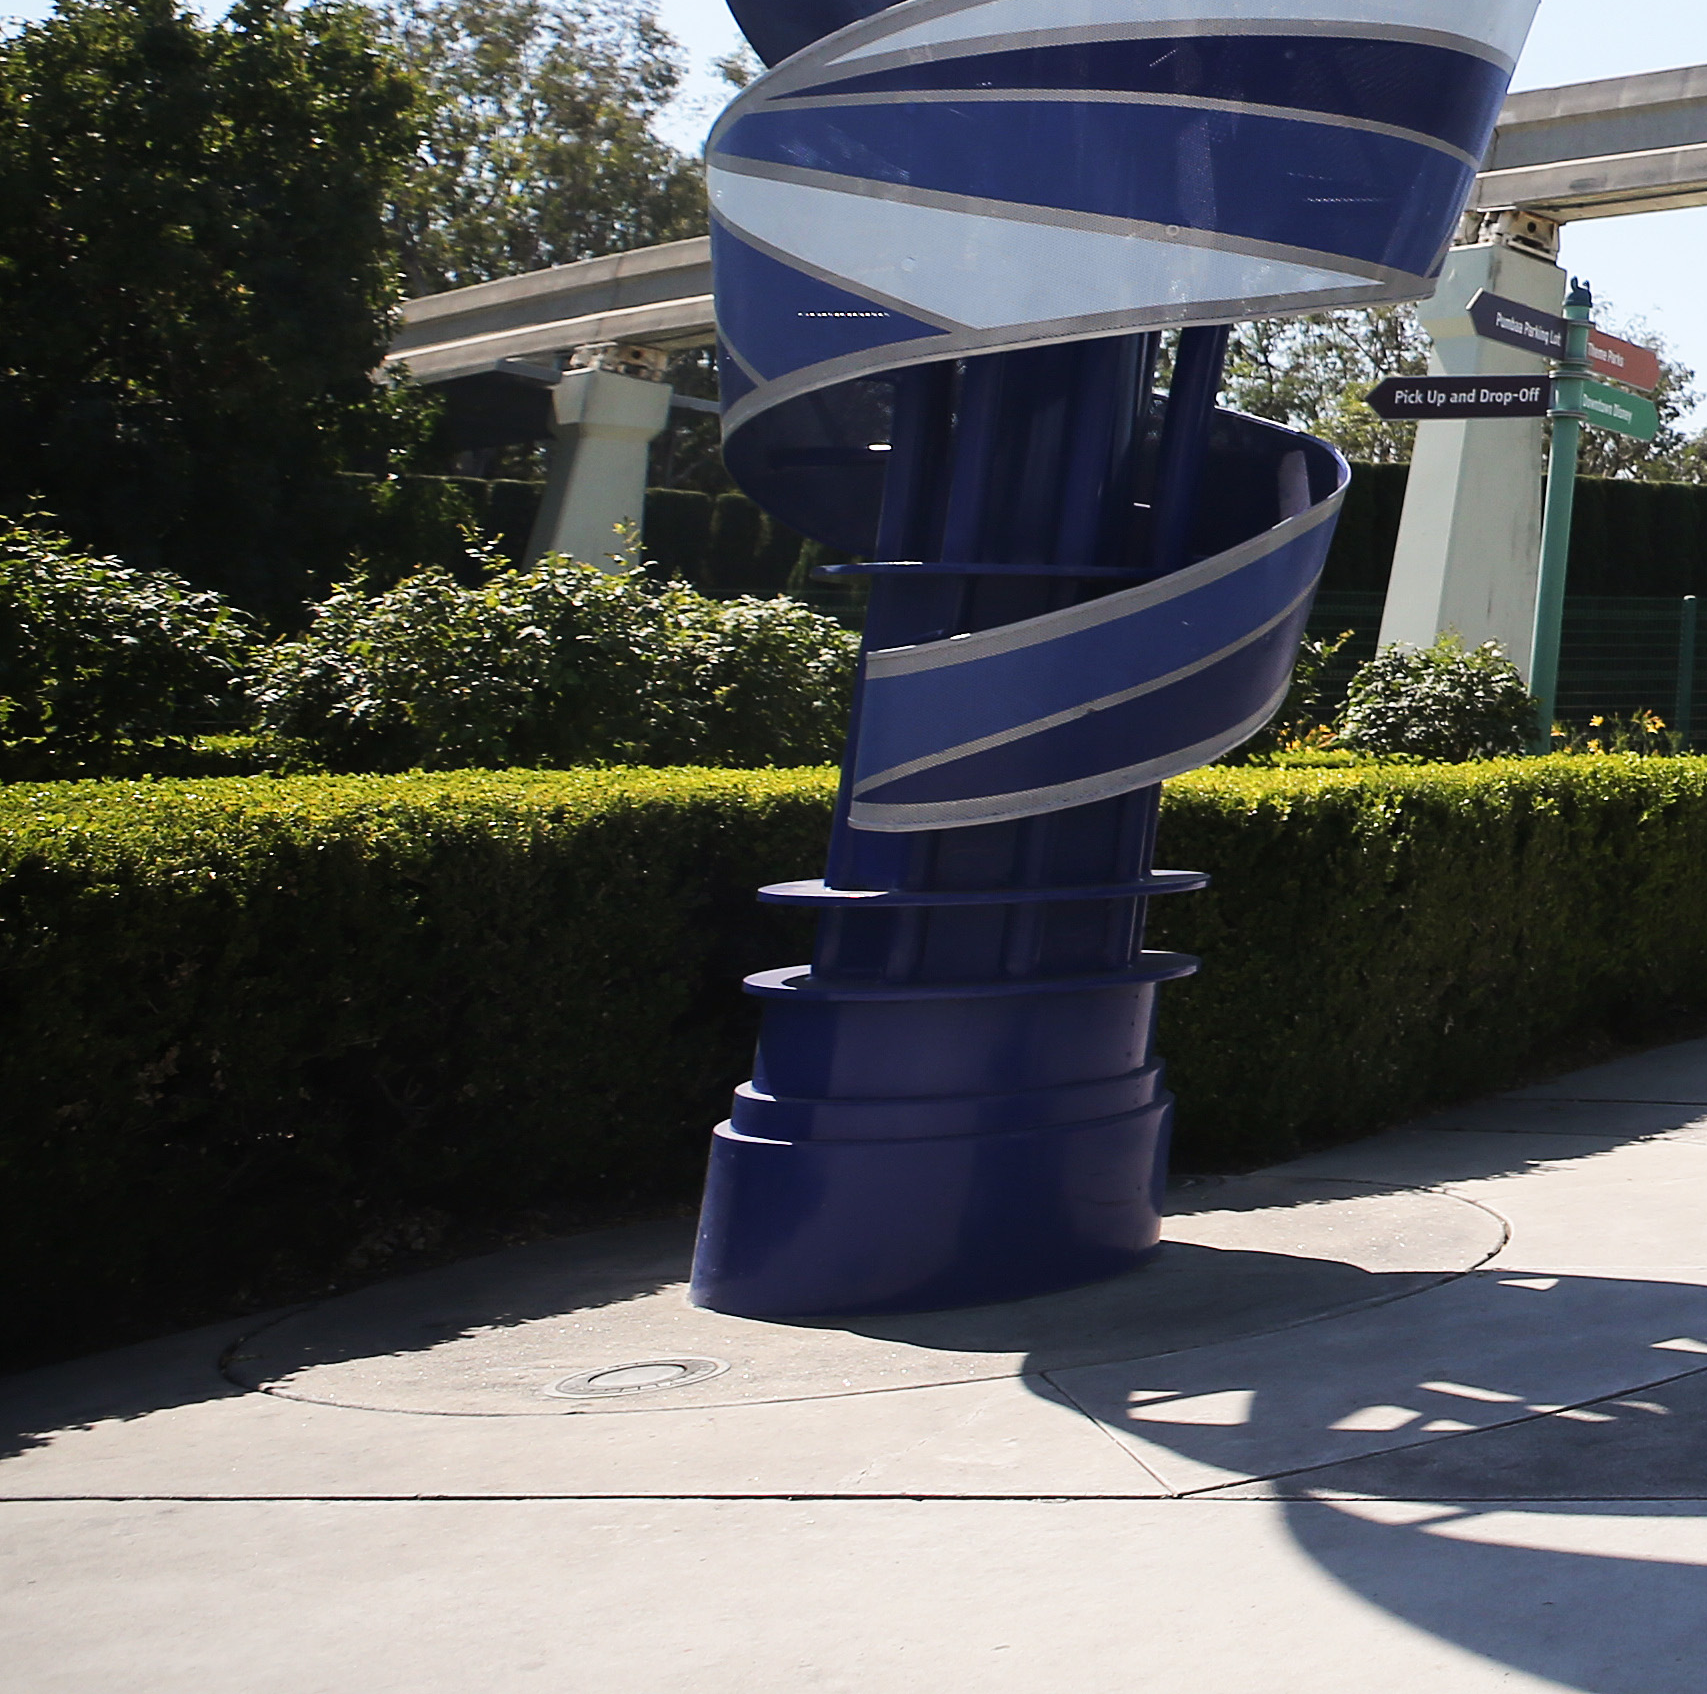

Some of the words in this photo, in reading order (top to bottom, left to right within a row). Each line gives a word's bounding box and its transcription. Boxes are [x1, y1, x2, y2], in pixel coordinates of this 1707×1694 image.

[1495, 311, 1524, 335] Pumbaa
[1523, 321, 1549, 345] Parking
[1548, 331, 1562, 348] Lot
[1607, 349, 1625, 368] Parks
[1394, 389, 1423, 405] Pick
[1426, 389, 1446, 407] Up
[1449, 388, 1476, 404] and
[1479, 387, 1541, 406] Drop-Off
